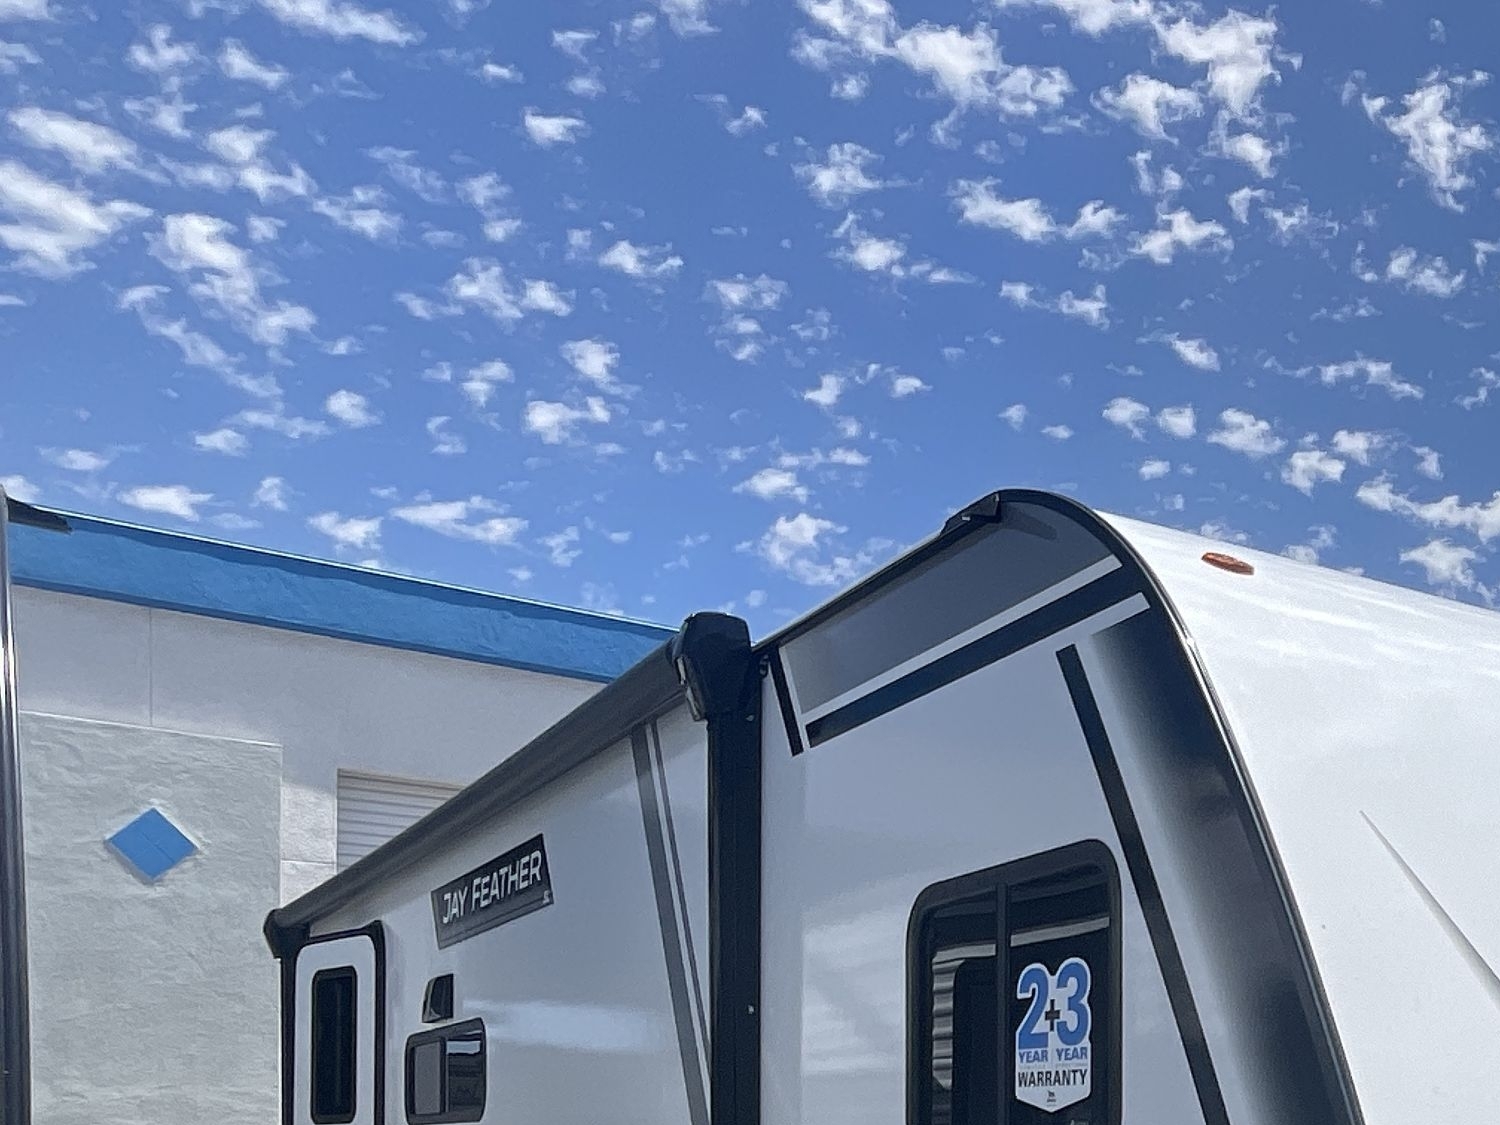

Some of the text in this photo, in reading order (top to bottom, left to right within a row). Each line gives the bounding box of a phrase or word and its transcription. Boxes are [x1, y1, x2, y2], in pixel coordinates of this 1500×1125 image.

[443, 850, 542, 924] JAY FEATHER
[1018, 1046, 1088, 1063] YEAR YEAR
[1018, 1069, 1088, 1087] WARRANTY
